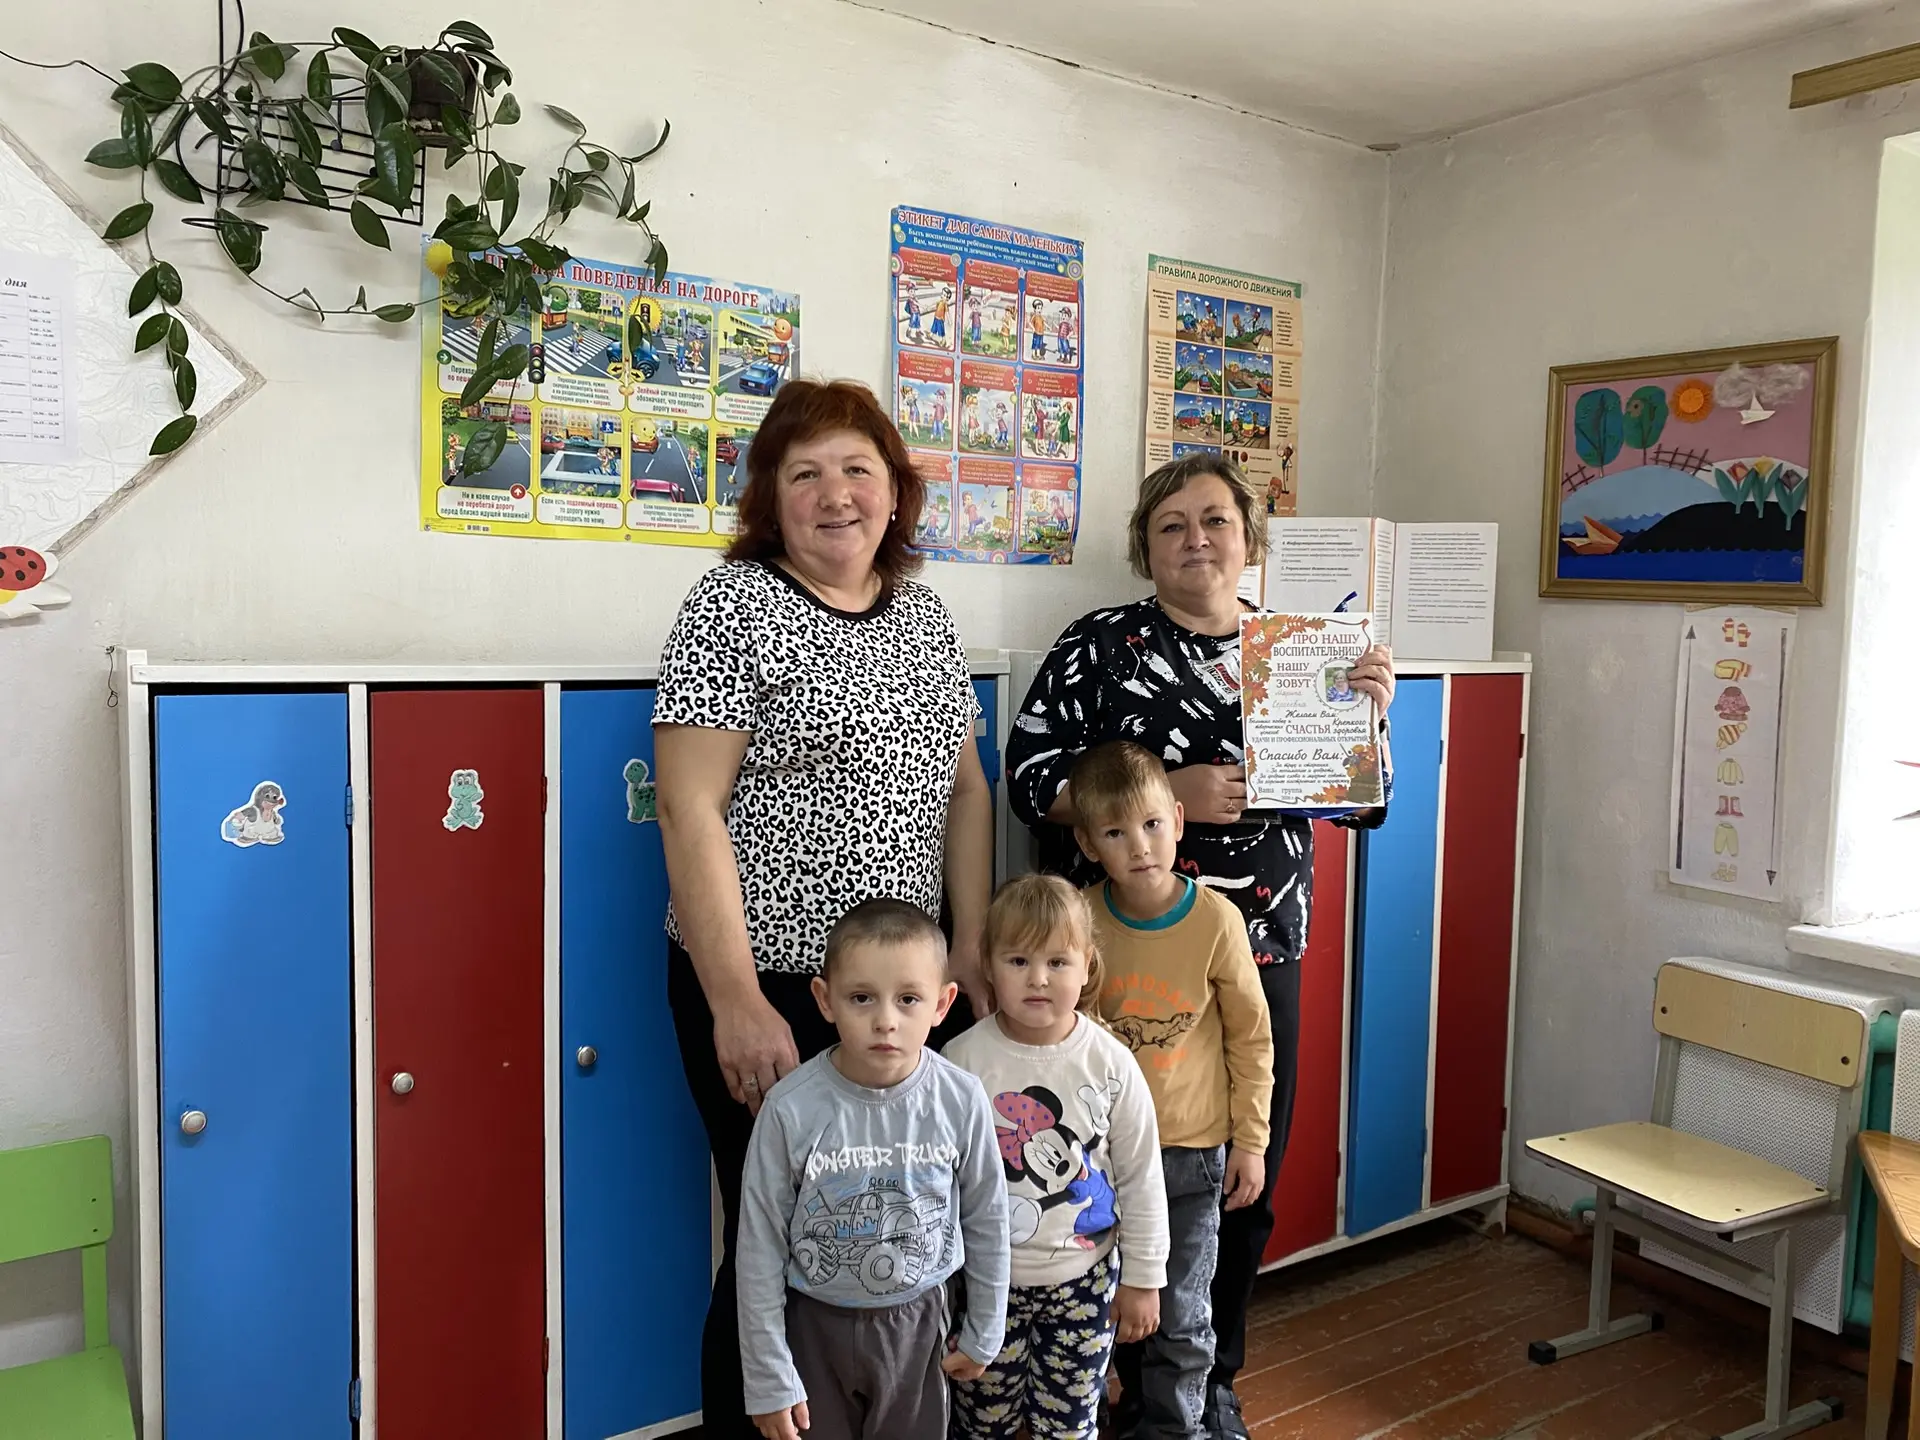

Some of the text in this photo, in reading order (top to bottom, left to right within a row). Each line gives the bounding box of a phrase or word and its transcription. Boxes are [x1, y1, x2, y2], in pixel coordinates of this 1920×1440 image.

[899, 210, 1077, 256] ЭТИКЕТ ДЛЯ САМЫХ МАЛЕНЬКИХ
[5, 277, 27, 288] дня
[1158, 265, 1292, 298] ПРАВИЛА ДОРОЖНОГО ДВИЖЕНИЯ
[677, 281, 698, 298] НА
[703, 286, 759, 308] ДОРОГЕ
[1293, 634, 1360, 644] ПРО НАШУ
[1273, 646, 1364, 657] ВОСПИТАТЕЛЬНИЦУ
[1276, 679, 1311, 688] ЗОВУТ
[1285, 710, 1317, 718] Желаем
[1286, 725, 1331, 734] СЧАСТЬЯ
[1260, 748, 1344, 761] Спасибо Вам:
